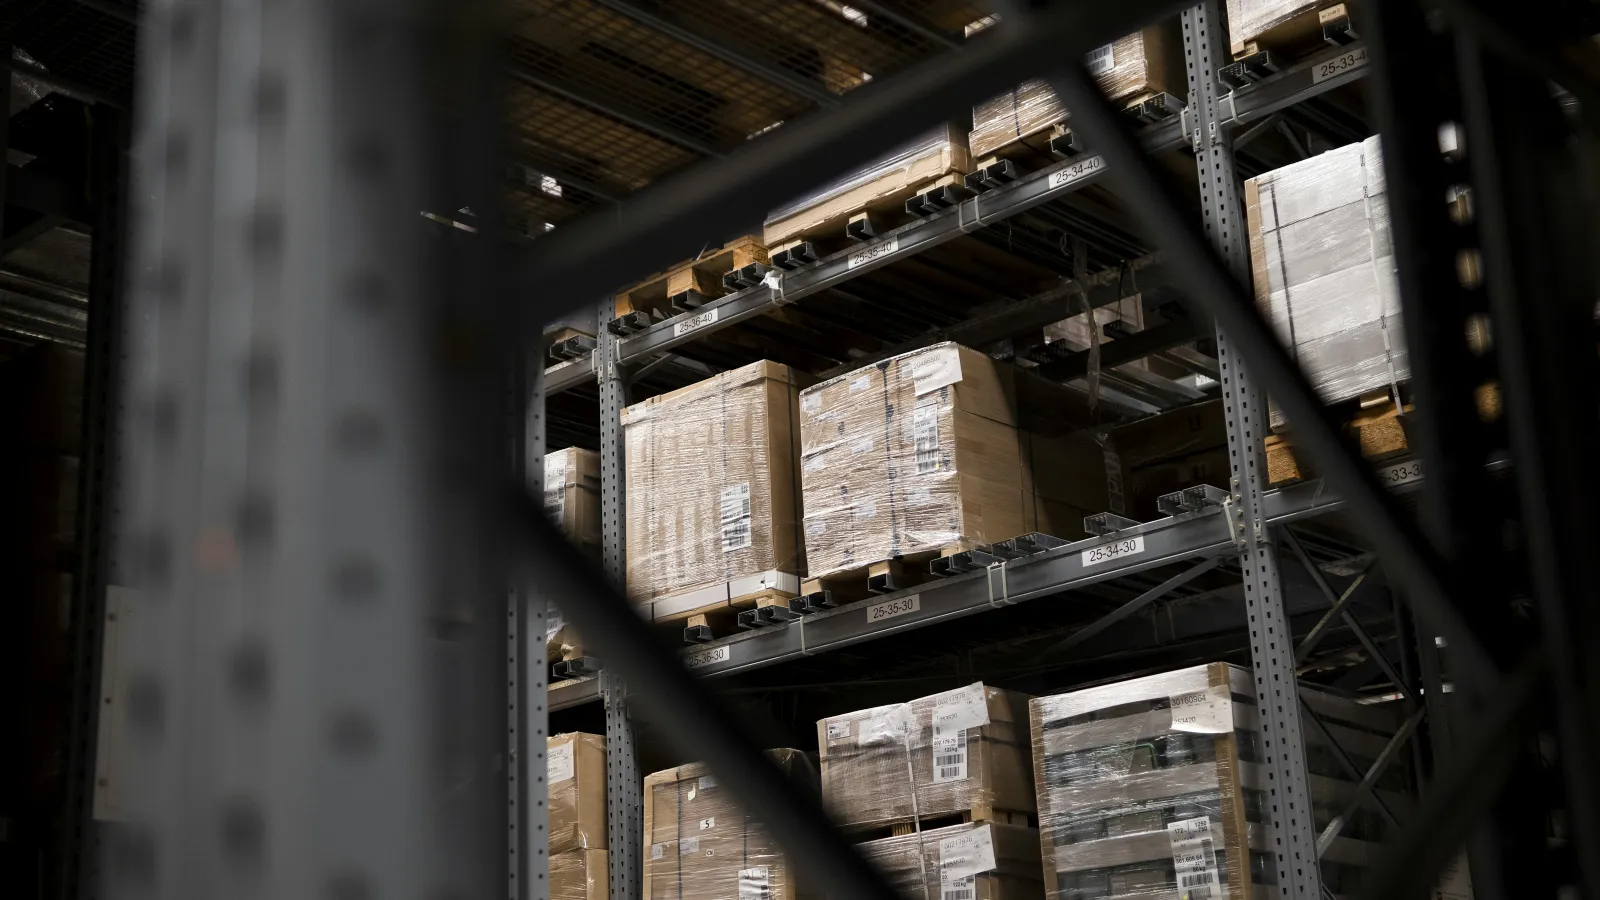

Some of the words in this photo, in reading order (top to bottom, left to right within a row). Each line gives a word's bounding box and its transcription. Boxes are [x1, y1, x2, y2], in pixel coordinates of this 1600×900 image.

[1056, 157, 1100, 184] 25-34-40
[854, 241, 892, 265] 25-35-40
[679, 312, 713, 333] 25-36-40
[1089, 539, 1136, 562] 25-34-30
[873, 598, 913, 619] 25-35-30
[688, 648, 724, 667] 25-36-30
[1171, 694, 1206, 707] 30160964
